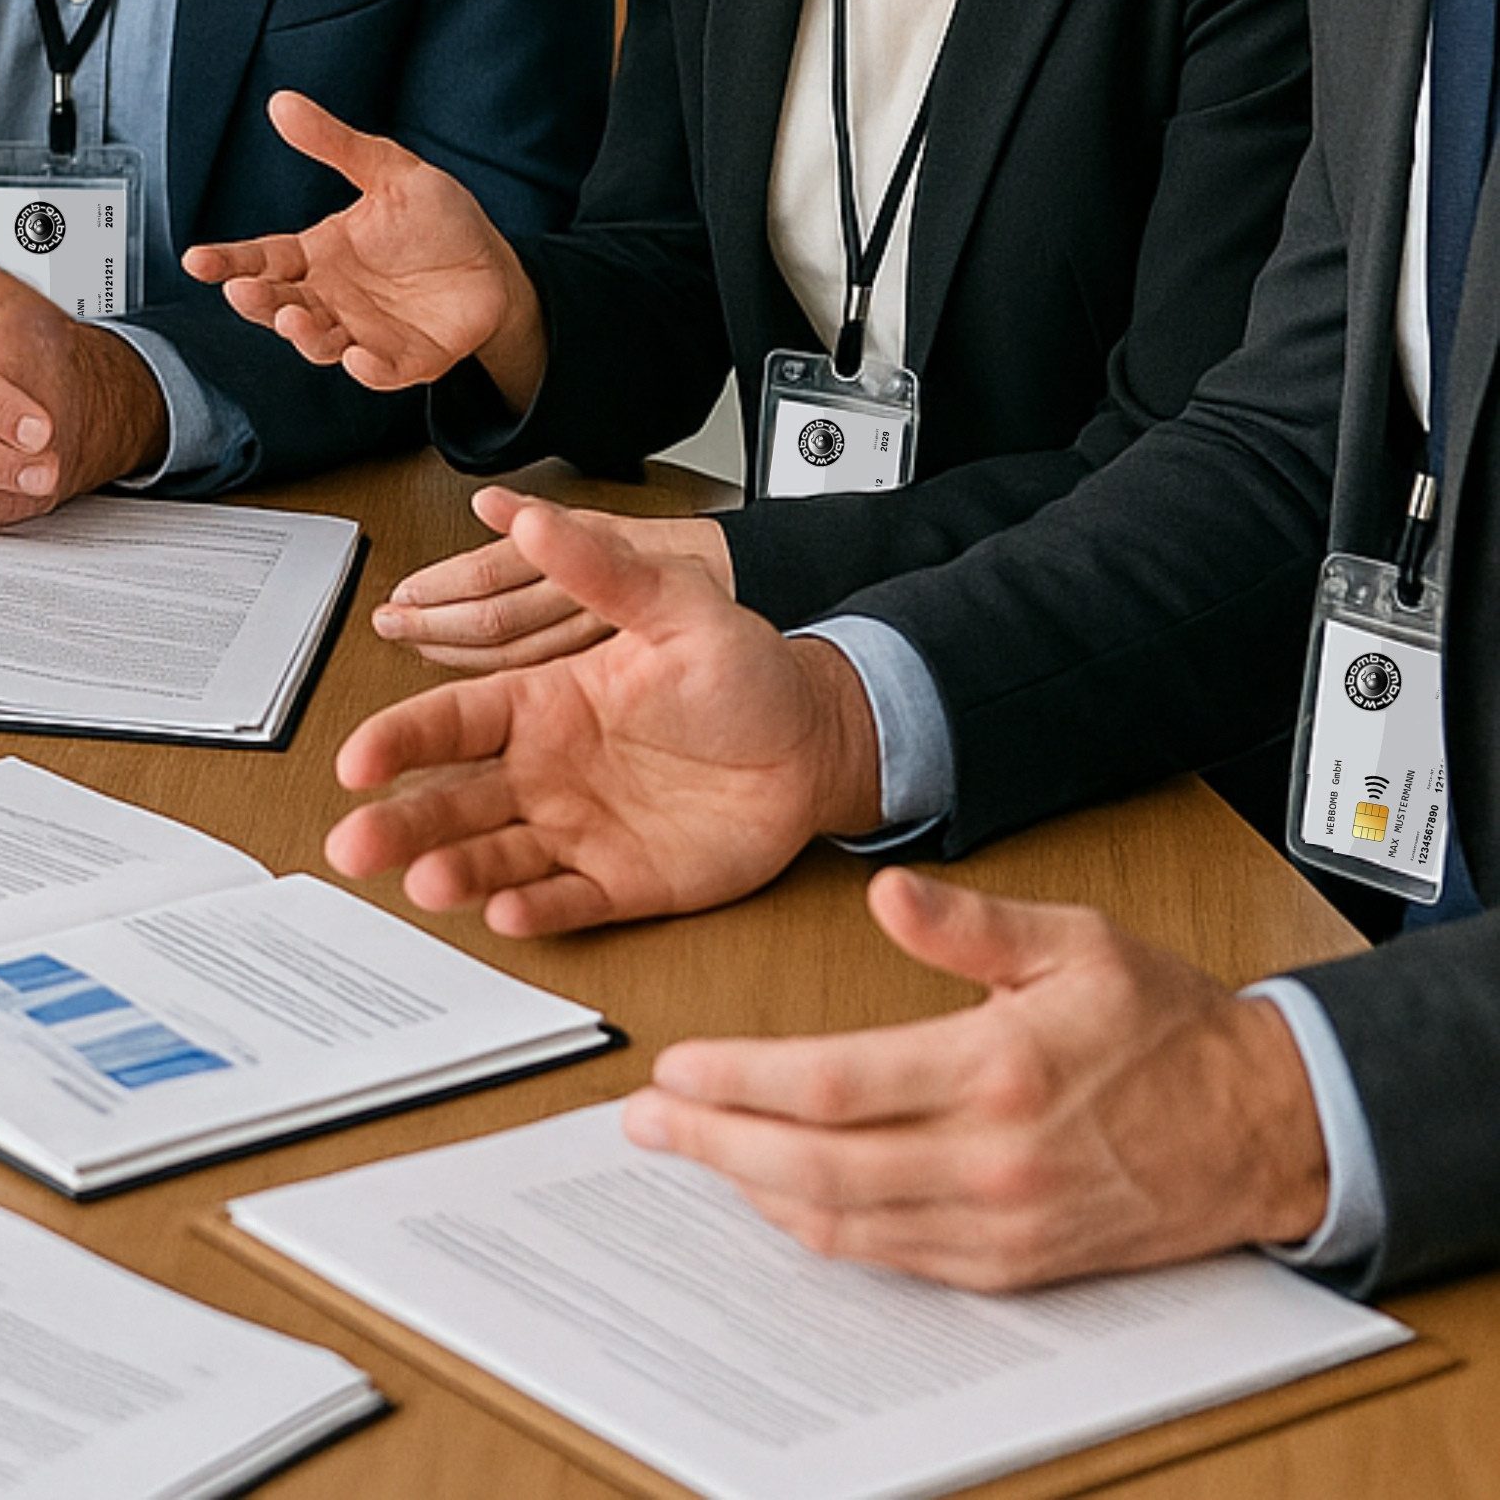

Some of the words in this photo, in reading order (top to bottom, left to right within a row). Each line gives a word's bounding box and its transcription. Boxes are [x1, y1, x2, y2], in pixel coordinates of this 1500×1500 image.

[105, 205, 114, 229] 2029
[105, 257, 114, 314] 1212121212
[77, 298, 85, 318] ANN
[880, 431, 890, 452] 2029
[1332, 759, 1342, 785] GmbH
[1326, 791, 1339, 835] WEBBOMB
[1388, 838, 1400, 858] MAX
[1394, 769, 1416, 833] MUSTERMANN
[1418, 804, 1439, 865] 1234567890
